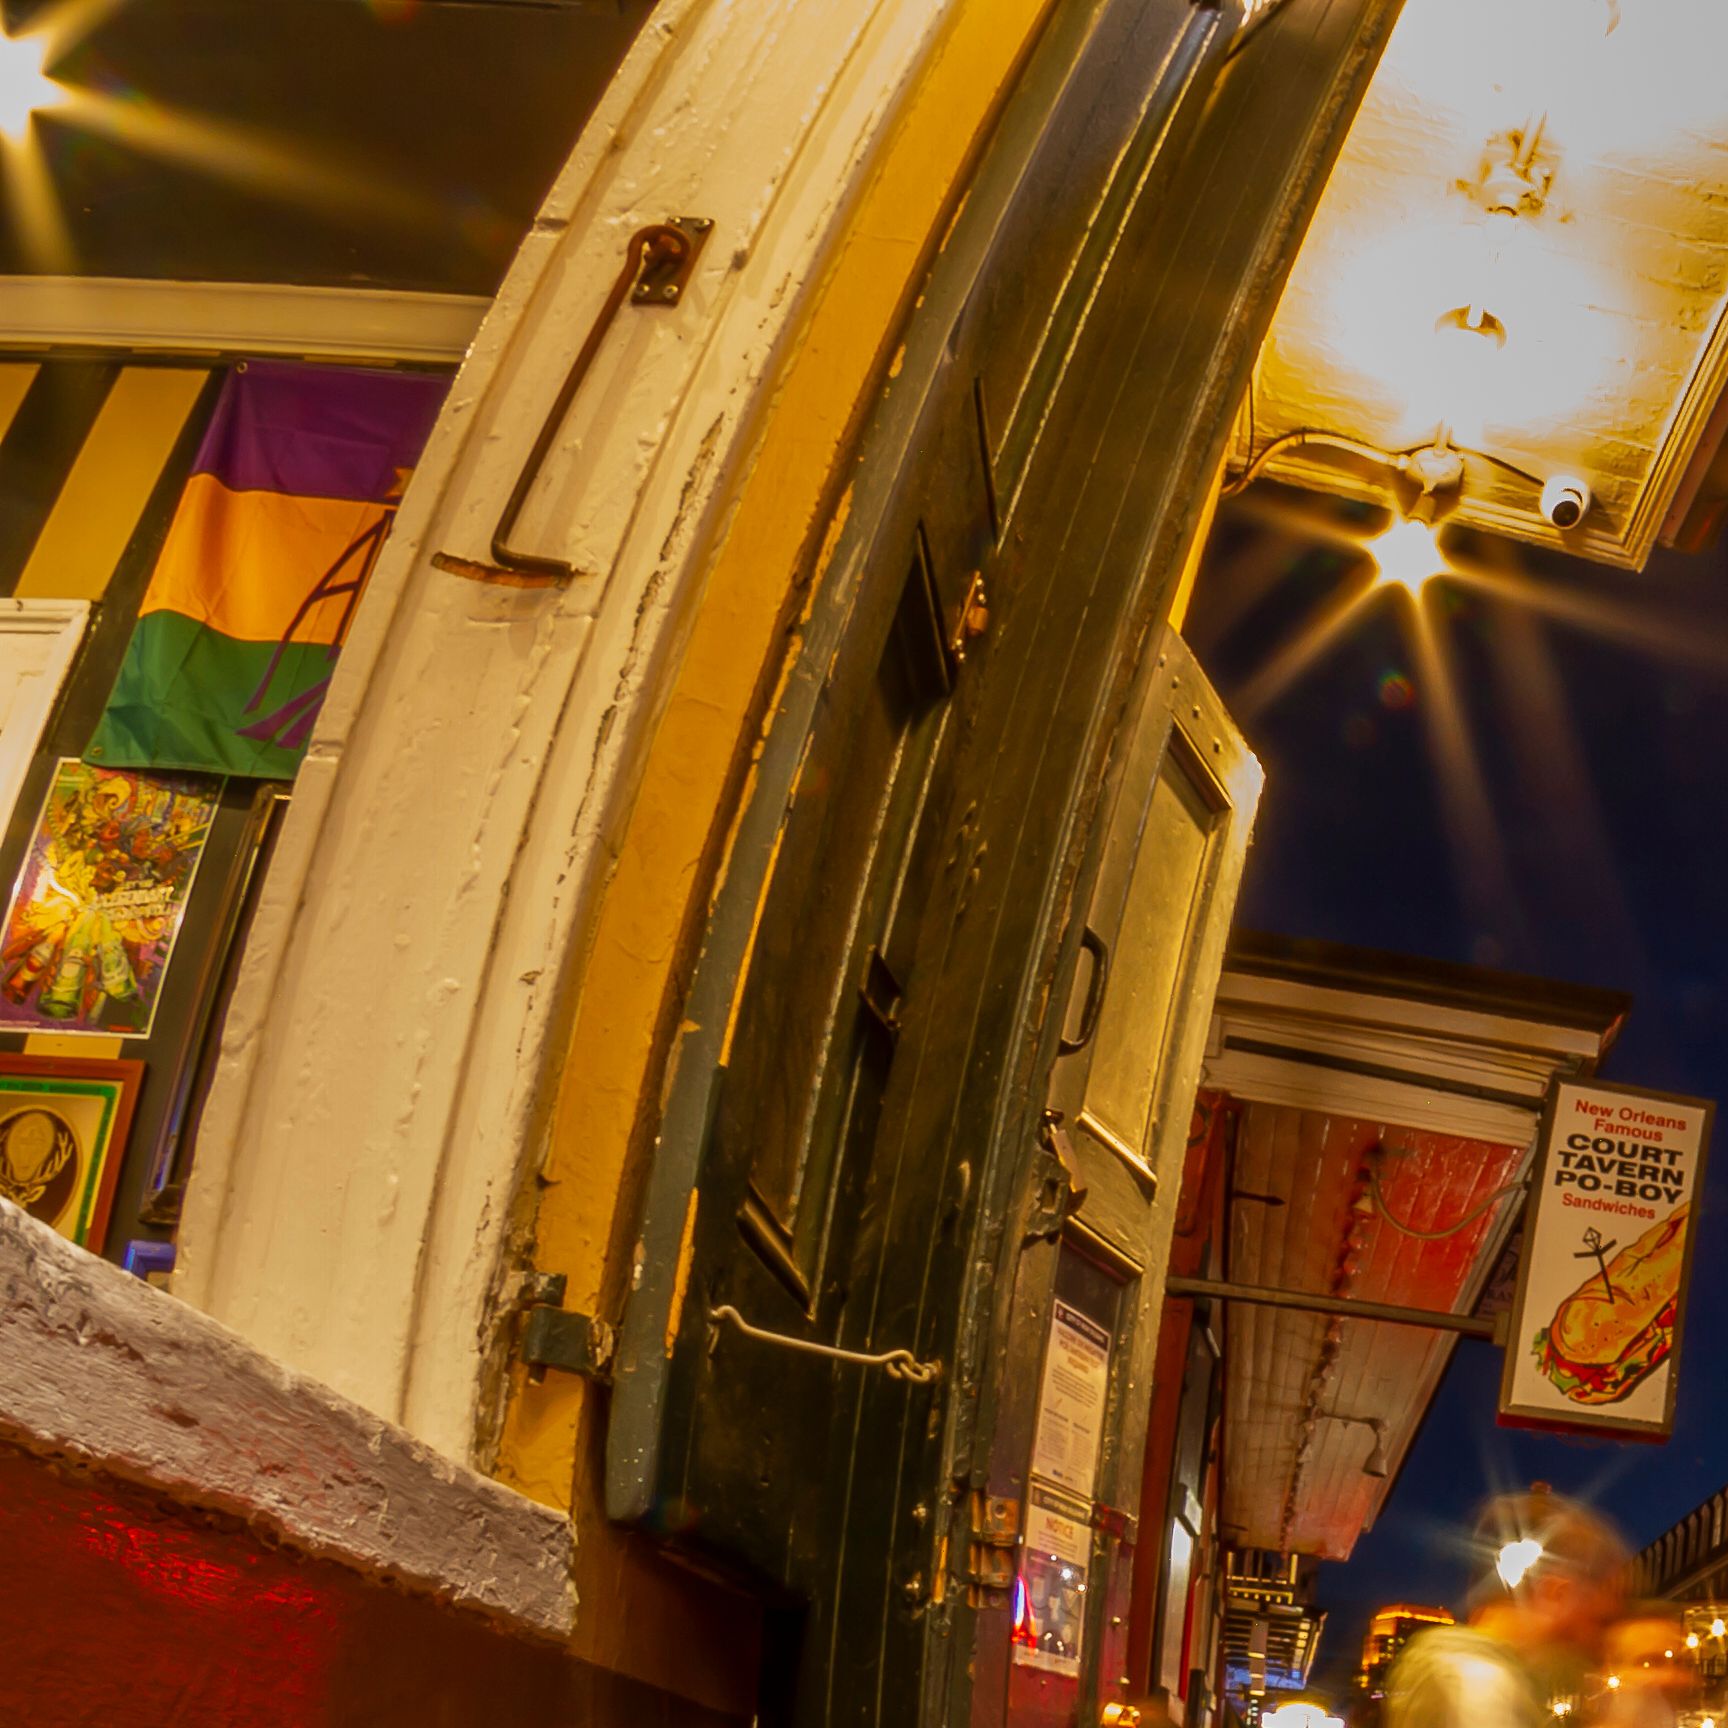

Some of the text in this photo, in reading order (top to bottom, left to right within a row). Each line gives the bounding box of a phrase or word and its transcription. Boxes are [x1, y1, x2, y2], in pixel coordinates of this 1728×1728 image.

[1574, 1099, 1687, 1131] New Orleans
[1594, 1118, 1663, 1142] Famous
[1567, 1133, 1683, 1166] COURT
[1558, 1151, 1684, 1187] TAVERN
[1554, 1170, 1684, 1205] PO-BOY
[1562, 1192, 1656, 1220] Sandwiches
